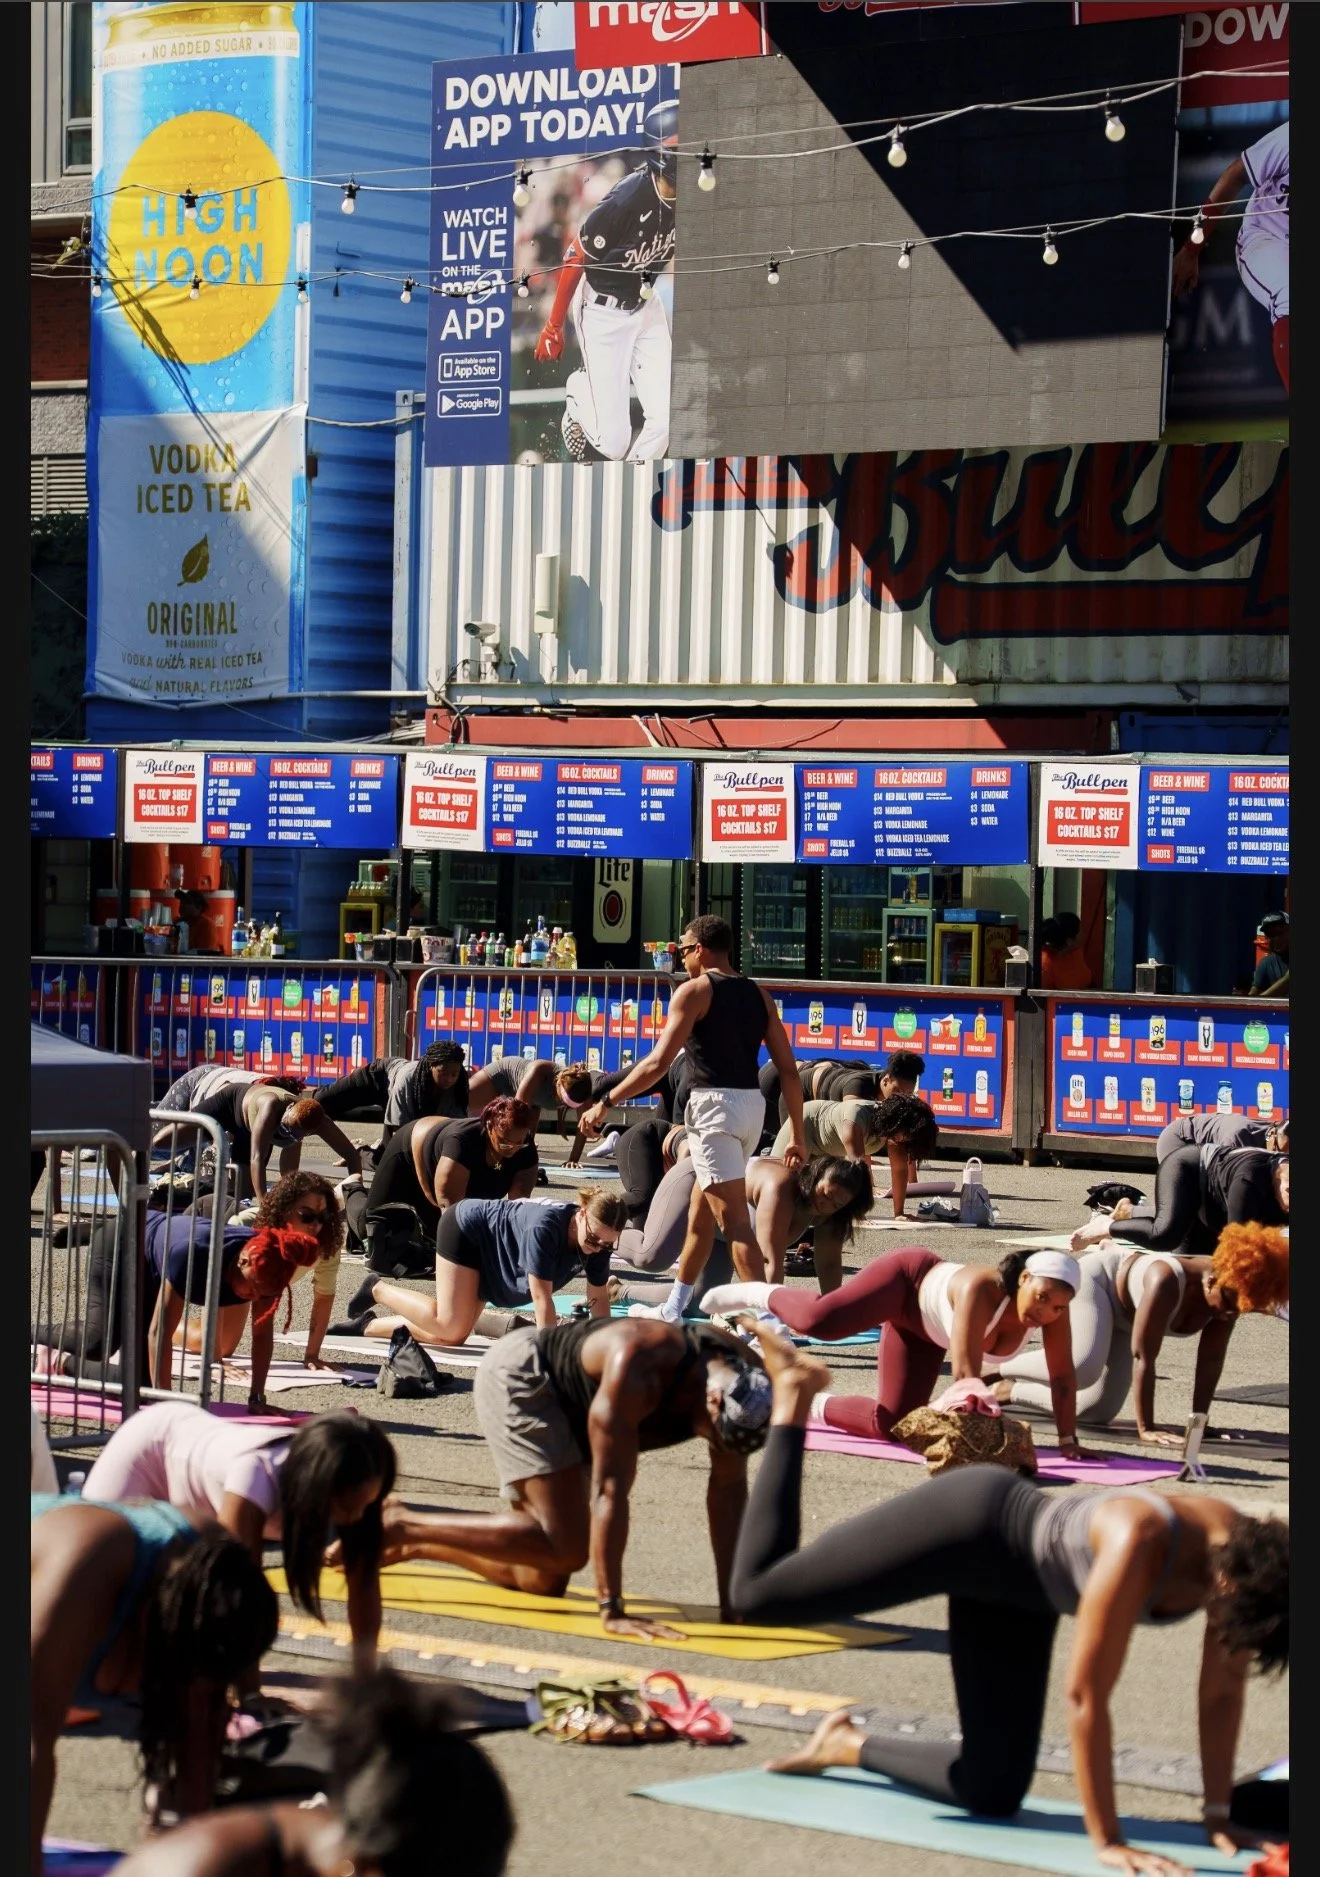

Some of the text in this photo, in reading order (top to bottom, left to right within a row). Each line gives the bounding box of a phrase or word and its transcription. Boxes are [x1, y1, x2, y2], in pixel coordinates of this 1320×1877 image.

[152, 44, 166, 60] NO
[170, 39, 210, 57] ADDED
[214, 36, 252, 53] SUGAR
[446, 65, 656, 110] DOWNLOAD
[444, 101, 645, 150] APP TODAY!
[443, 207, 507, 229] WATCH
[134, 189, 263, 289] HIGH NOON
[442, 228, 507, 261] LIVE
[442, 264, 481, 278] ON THE
[440, 307, 505, 341] APP
[454, 364, 496, 378] App Store
[456, 397, 499, 410] Google Play
[149, 443, 238, 474] VODKA
[137, 482, 251, 513] ICED TEA
[147, 601, 238, 636] ORIGINAL
[121, 652, 263, 670] VODKA with REAL ICED TEA
[156, 681, 205, 693] NATURAL
[210, 677, 253, 692] FLAVORS
[76, 756, 101, 767] DRINKS
[212, 762, 253, 773] BEER & WINE
[274, 763, 328, 774] 16 OZ. COCKTAILS
[355, 763, 381, 774] DRINKS
[496, 765, 539, 778] BEER & WINE
[561, 767, 617, 780] 16 OZ. COCKTAILS
[646, 769, 674, 781] DRINKS
[807, 772, 854, 784] BEER & WINE
[879, 771, 943, 784] 16 OZ. COCKTAILS
[976, 770, 1007, 784] DRINKS
[1153, 775, 1206, 788] BEER & WINE
[1234, 776, 1244, 788] 16
[1244, 776, 1258, 788] OZ.
[138, 789, 192, 801] 16 OZ. TOP SHELF
[416, 791, 473, 807] 16 OZ. TOP SHELF
[1228, 798, 1239, 806] $14
[1242, 798, 1252, 806] RED
[1253, 798, 1267, 807] BULL
[141, 805, 189, 817] COCKTAILS $17
[419, 808, 469, 823] COCKTAILS $17
[717, 804, 781, 817] 16 OZ. TOP SHELF
[1054, 807, 1124, 821] 16 OZ. TOP SHELF
[720, 821, 778, 835] COCKTAILS $17
[1058, 825, 1119, 839] COCKTAILS $17
[1151, 849, 1171, 859] SHOTS
[598, 858, 630, 888] Lite
